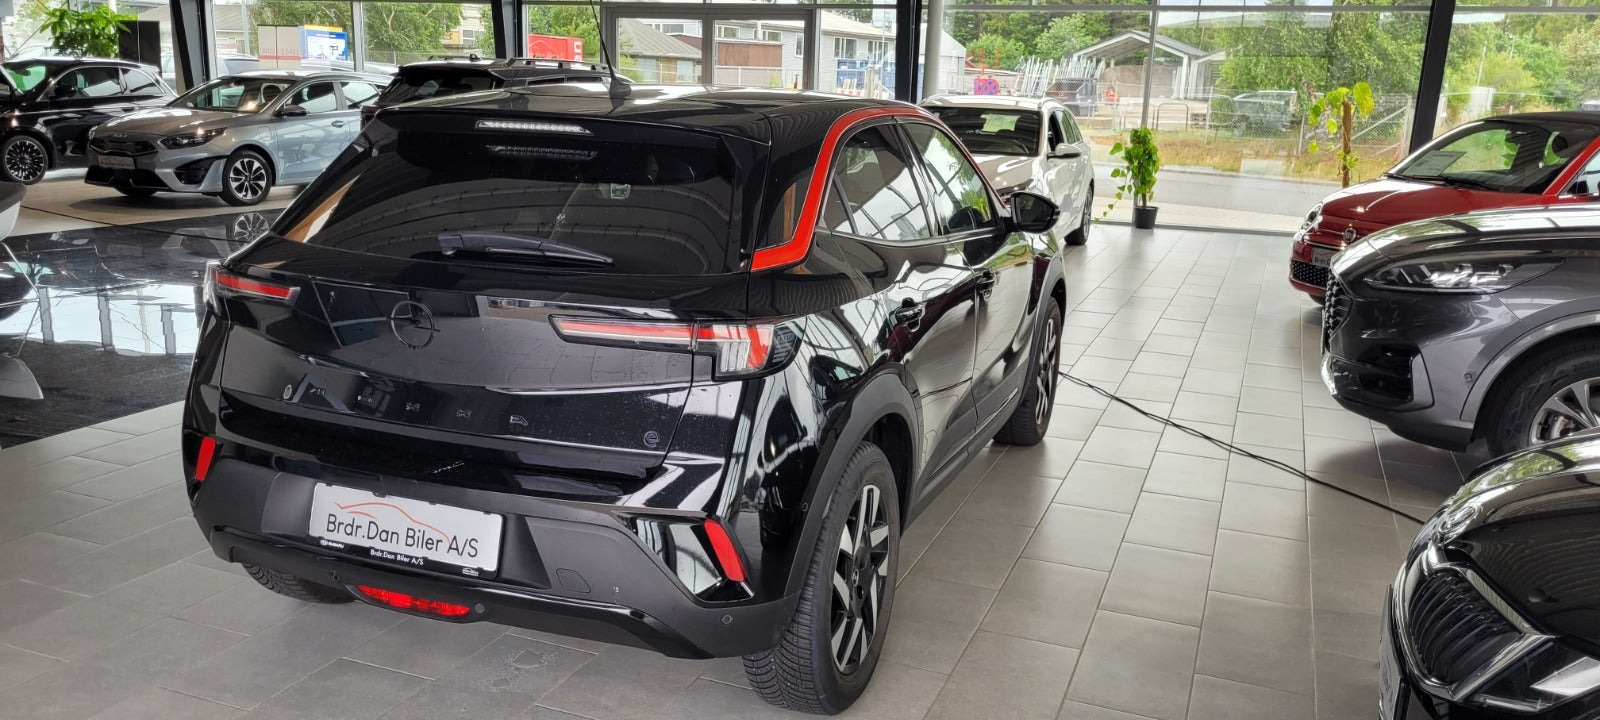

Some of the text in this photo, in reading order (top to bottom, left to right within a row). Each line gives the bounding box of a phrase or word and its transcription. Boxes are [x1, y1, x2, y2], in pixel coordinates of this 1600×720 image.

[326, 513, 479, 558] Brdr.Dan Biler A/S
[370, 548, 424, 566] Brdr.Dan Biler A/S
